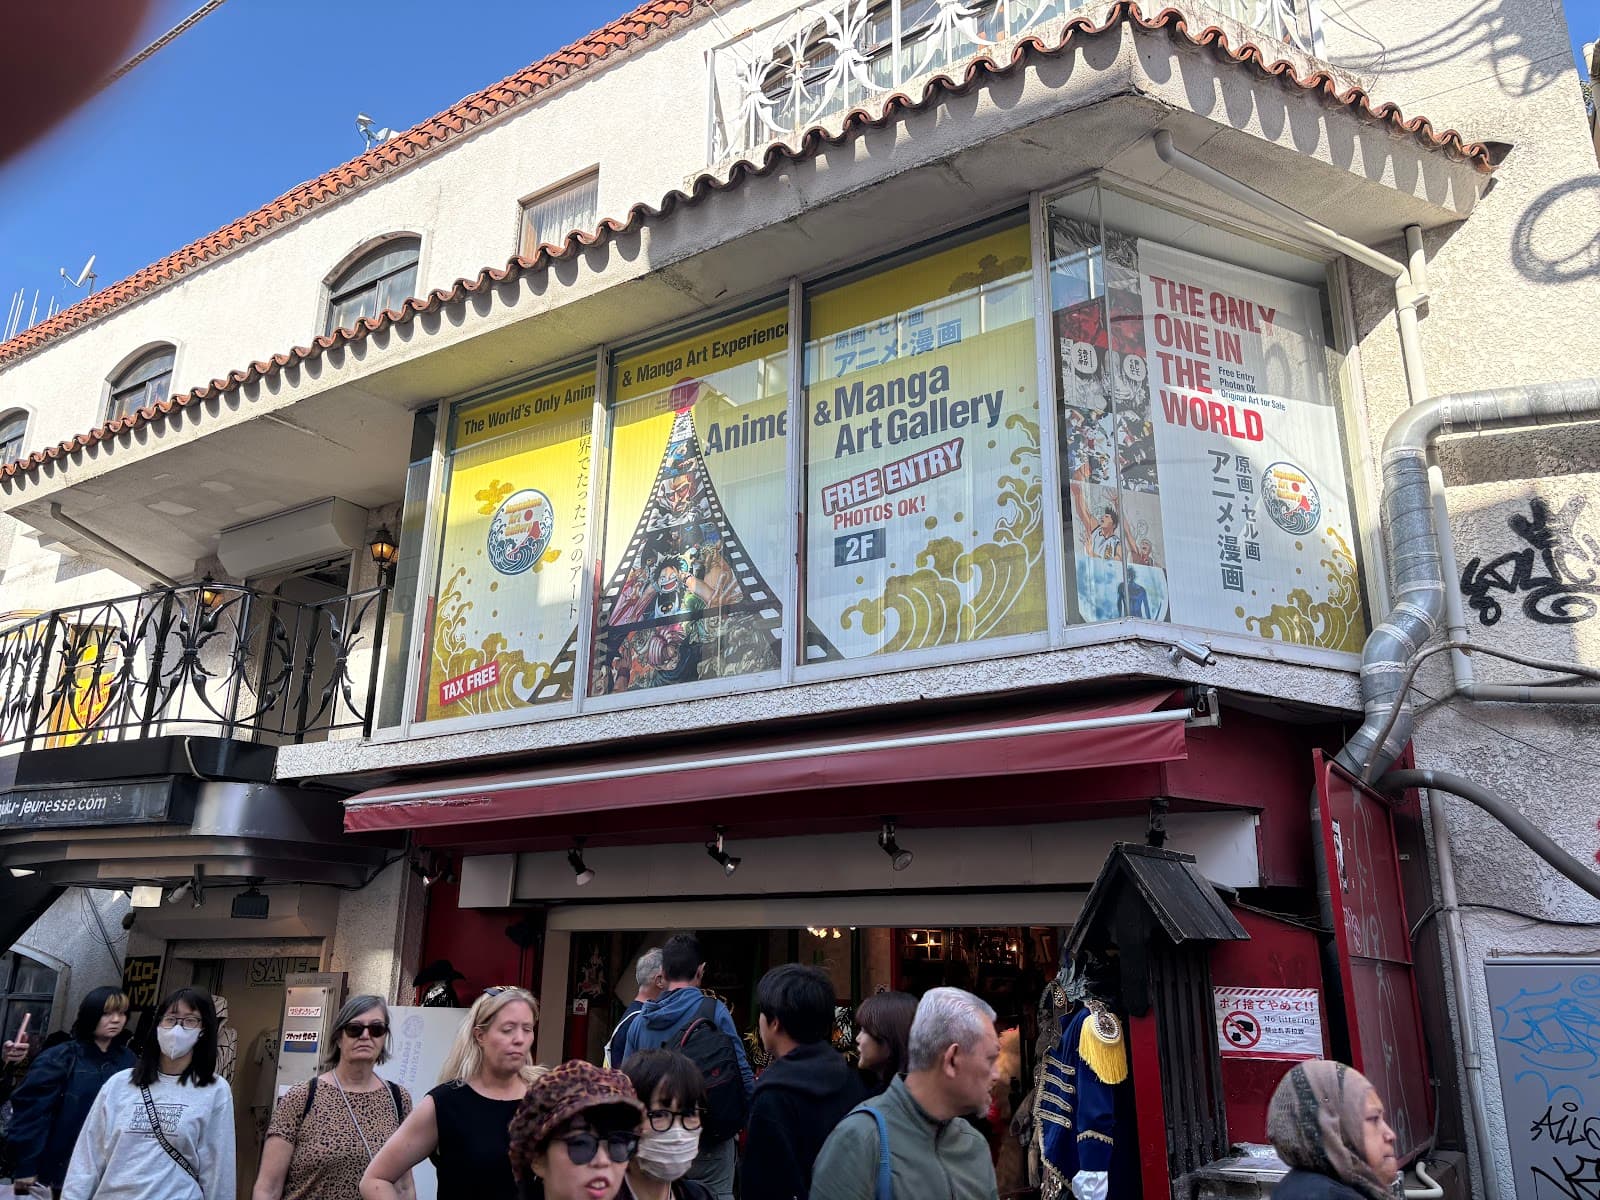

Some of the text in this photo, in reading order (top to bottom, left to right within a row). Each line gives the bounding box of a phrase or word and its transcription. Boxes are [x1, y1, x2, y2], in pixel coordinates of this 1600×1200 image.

[1149, 275, 1276, 336] THE ONLY
[1154, 313, 1243, 364] ONE IN
[622, 370, 633, 387] &
[636, 356, 682, 383] Manga
[686, 347, 708, 368] Art
[1155, 350, 1213, 394] THE
[1217, 366, 1255, 385] Free Entry
[1219, 378, 1257, 394] Photos OK
[464, 418, 485, 436] The
[488, 404, 531, 428] World's
[534, 394, 562, 414] Only
[813, 364, 950, 427] & Manga
[1159, 389, 1264, 442] WORLD
[1220, 389, 1286, 412] Original Art for Sale
[704, 410, 786, 457] Anime
[834, 389, 1005, 459] Art Gallery
[824, 439, 962, 514] FREE ENTRY
[833, 495, 927, 531] PHOTOS OK!
[1207, 449, 1245, 593] アニメ・漫画
[845, 534, 874, 562] 2F
[442, 665, 497, 700] TAX FREE
[124, 959, 161, 982] イエロー
[1264, 1015, 1315, 1026] No littering
